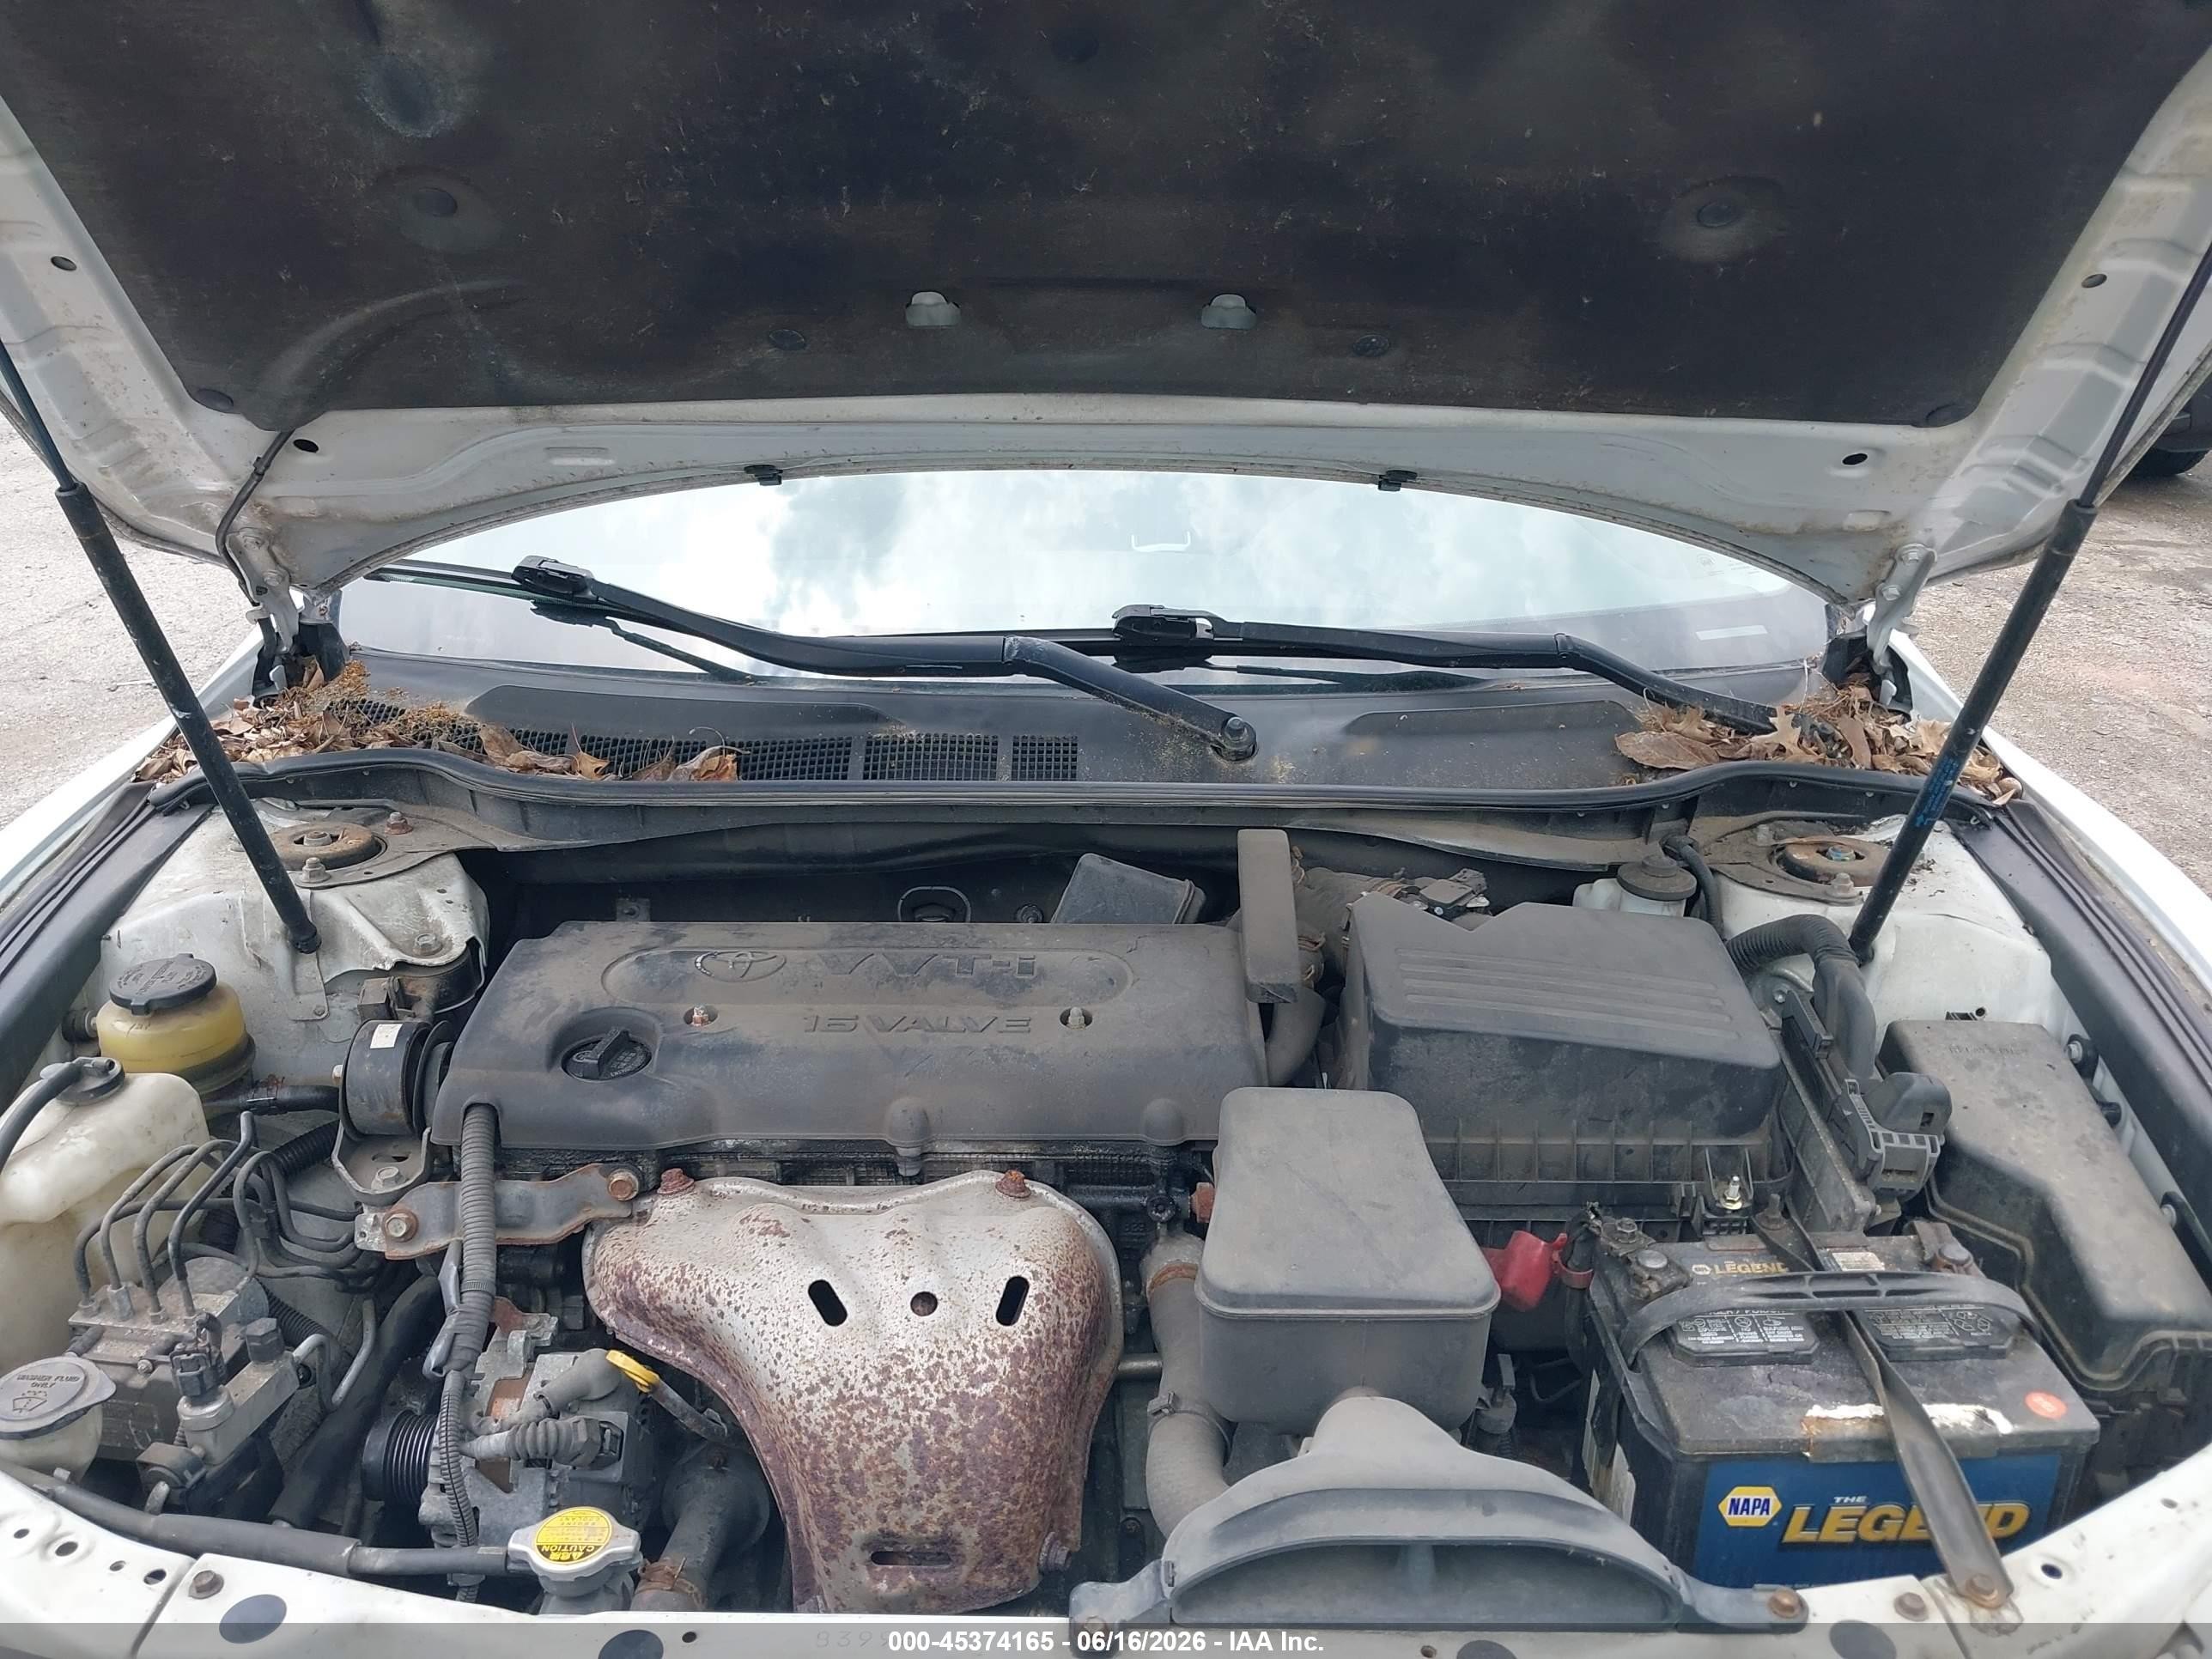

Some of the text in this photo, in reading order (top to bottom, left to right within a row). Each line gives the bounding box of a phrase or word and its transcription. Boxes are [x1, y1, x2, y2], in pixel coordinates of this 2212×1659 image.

[866, 1015, 1032, 1034] VALVE
[1728, 1497, 1771, 1516] NAPA
[1781, 1504, 2031, 1544] LEGED
